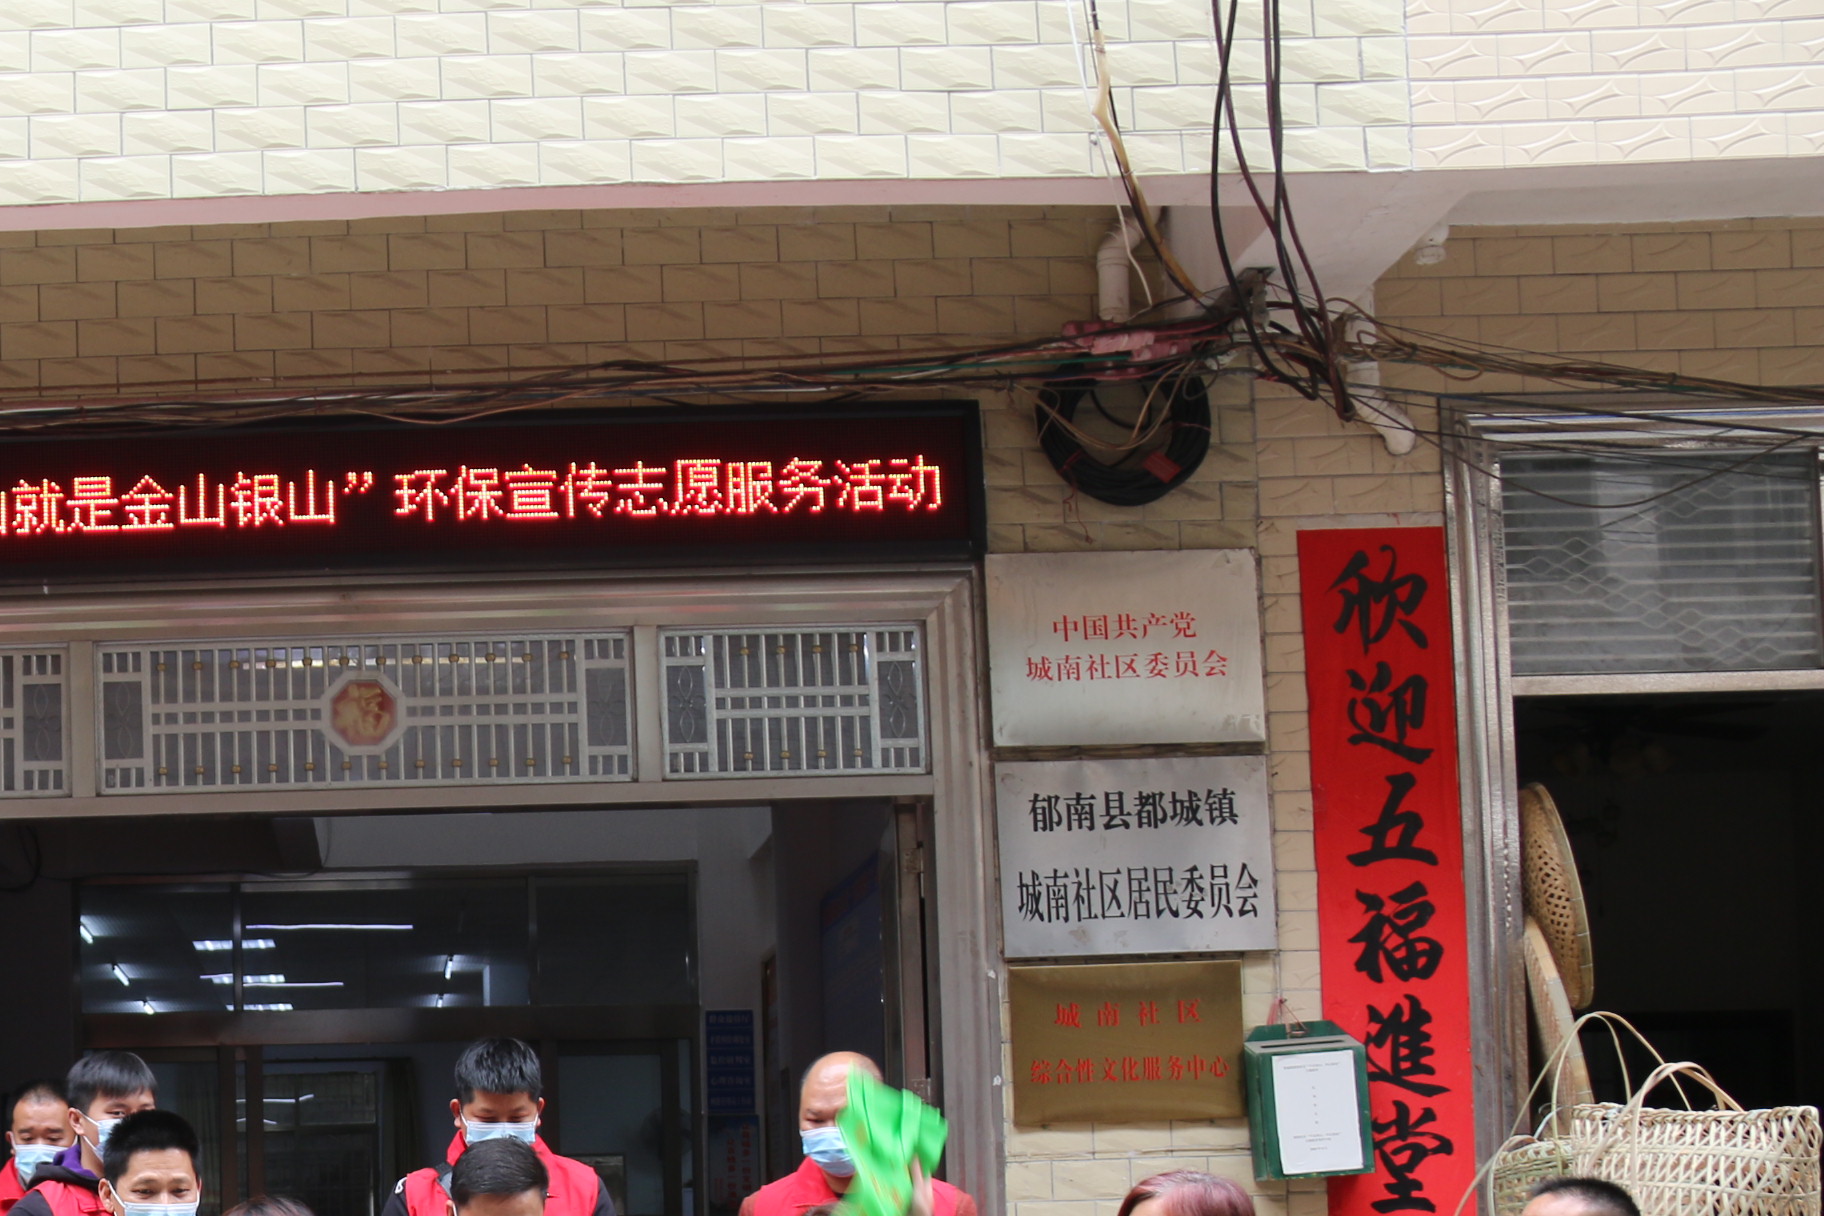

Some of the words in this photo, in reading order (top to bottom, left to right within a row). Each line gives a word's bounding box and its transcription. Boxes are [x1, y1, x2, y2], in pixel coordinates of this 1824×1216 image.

[393, 455, 944, 519] 环保宣传志愿服务活动
[1052, 611, 1198, 643] 中国共产党
[1025, 650, 1229, 681] 城南社区委员会
[1028, 787, 1239, 832] 郁南县都城镇
[1017, 862, 1260, 923] 城南社区居民委员会
[1054, 998, 1204, 1028] 城南社区
[1030, 1054, 1231, 1085] 综合性文化服务中心
